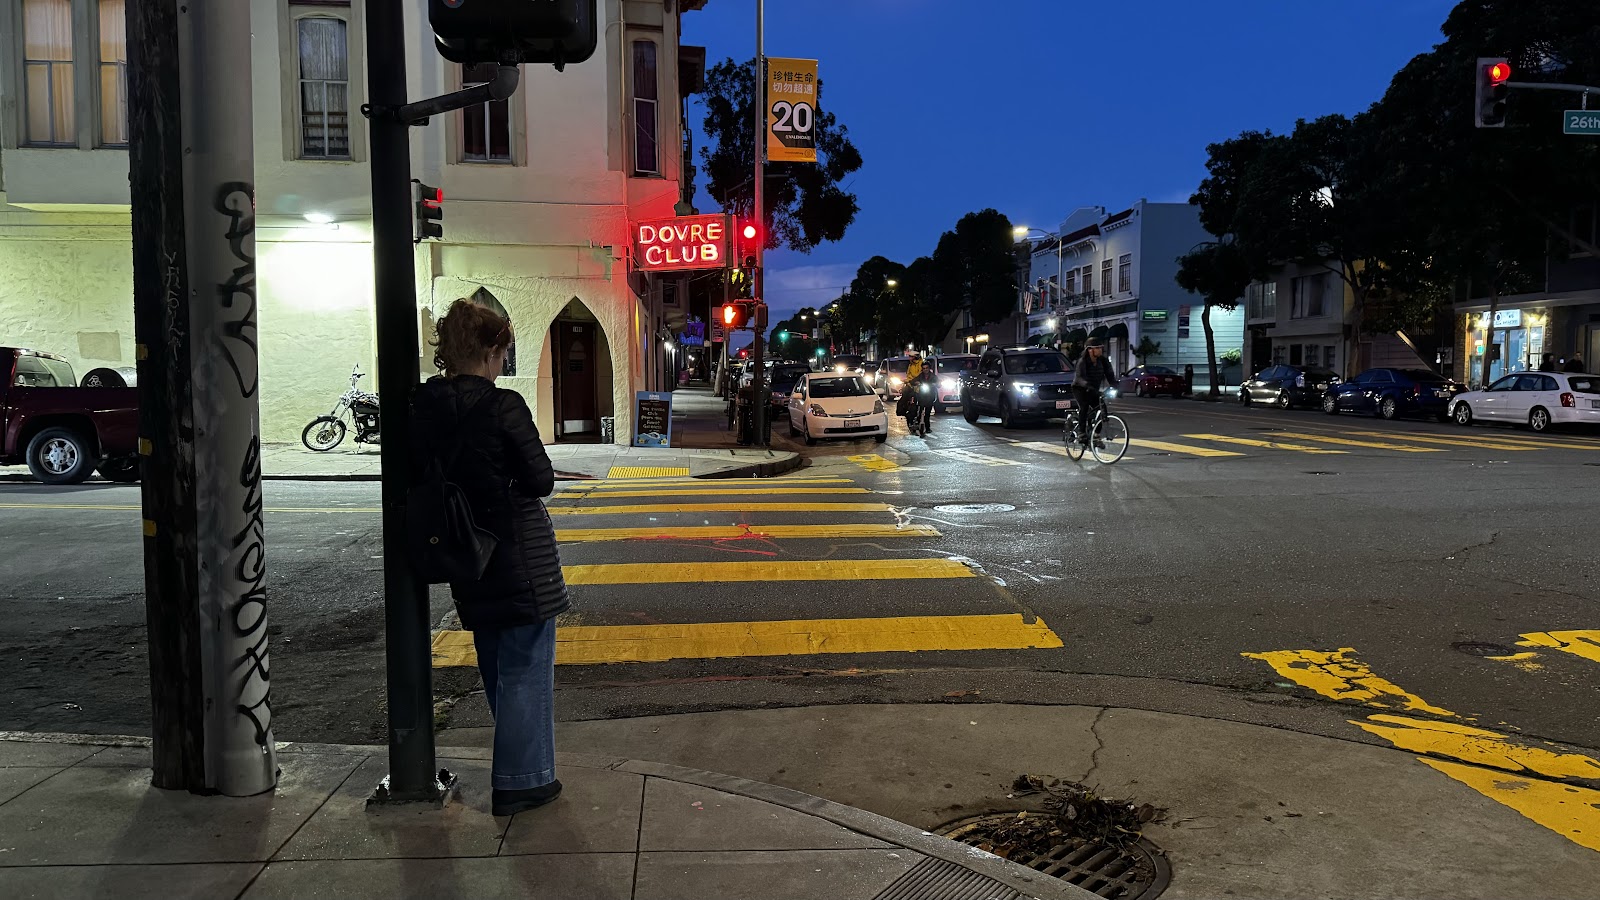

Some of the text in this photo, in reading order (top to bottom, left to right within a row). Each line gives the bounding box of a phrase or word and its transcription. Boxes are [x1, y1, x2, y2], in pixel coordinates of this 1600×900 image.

[773, 71, 813, 83] 珍惜生命
[773, 82, 813, 94] 切勿超速
[772, 101, 813, 133] 20
[1570, 116, 1600, 128] 26th
[639, 223, 722, 244] DOVRE
[646, 244, 718, 265] CLUB
